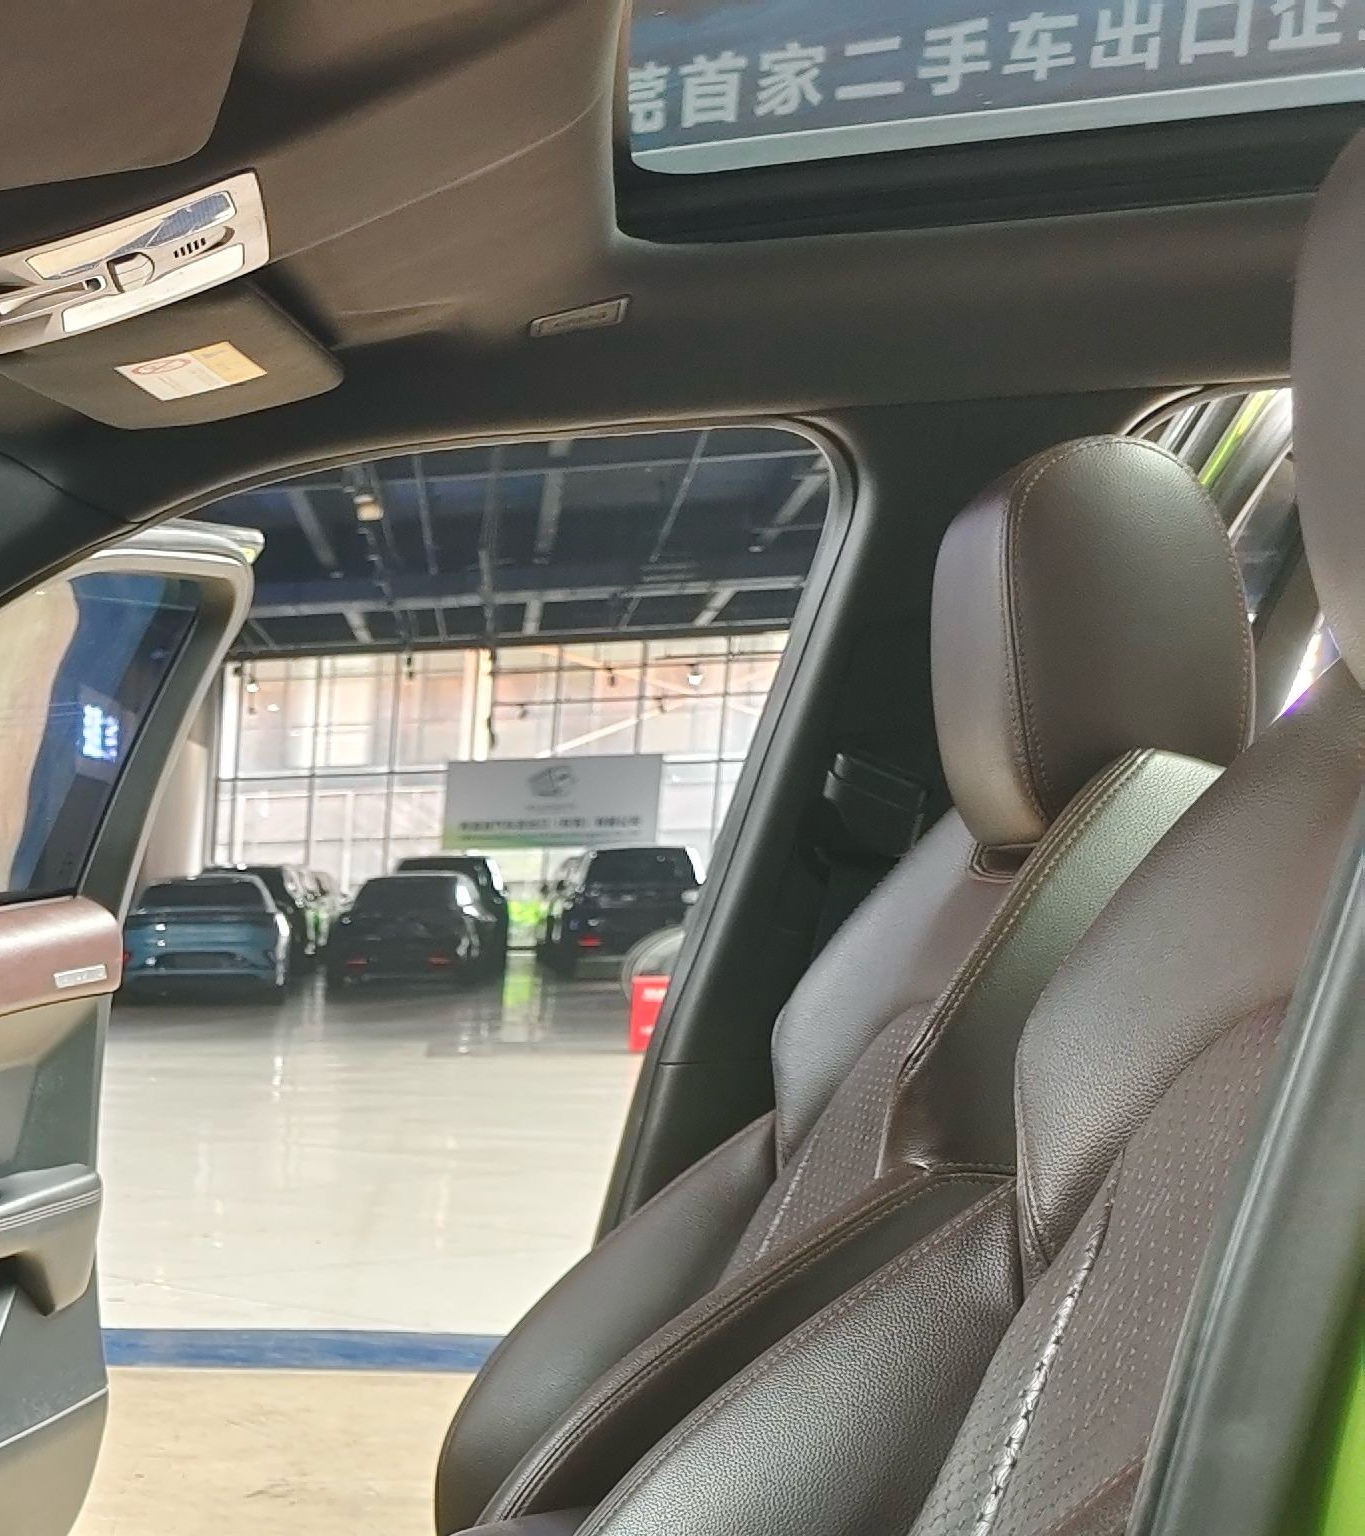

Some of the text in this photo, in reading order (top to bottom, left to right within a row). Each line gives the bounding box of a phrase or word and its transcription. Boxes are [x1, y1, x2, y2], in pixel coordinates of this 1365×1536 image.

[628, 0, 1365, 133] 莞首家二手车出口企
